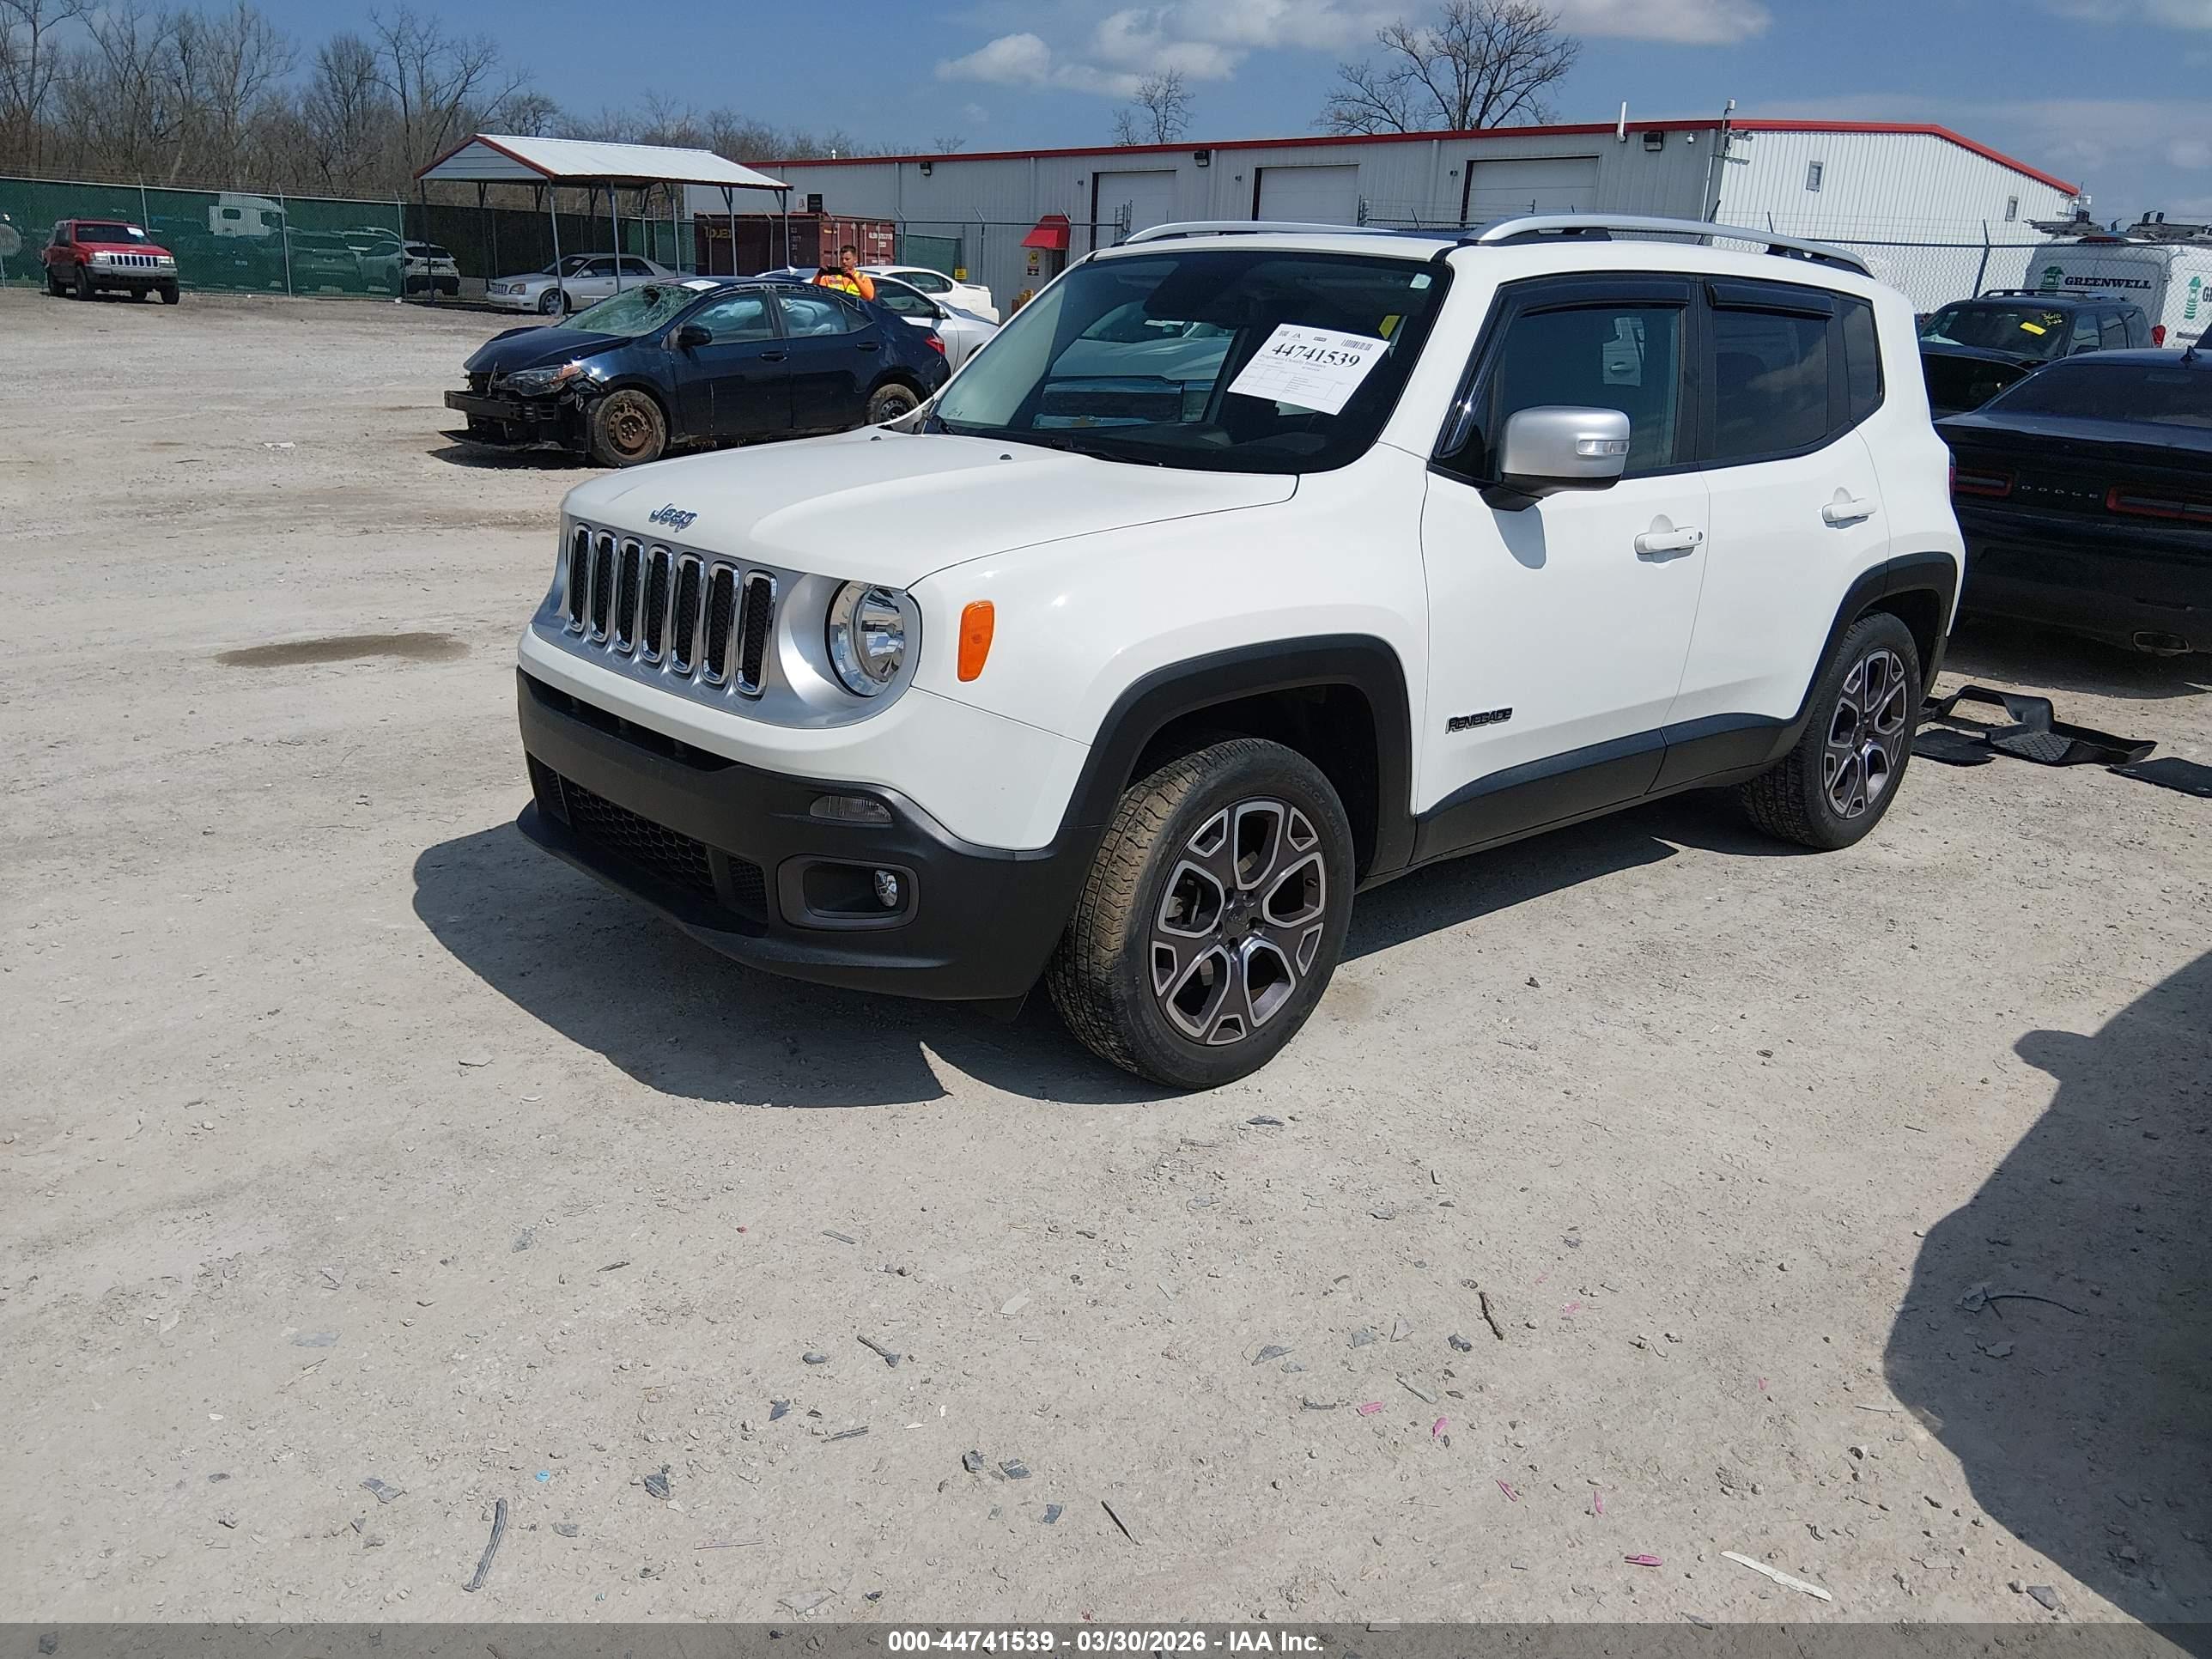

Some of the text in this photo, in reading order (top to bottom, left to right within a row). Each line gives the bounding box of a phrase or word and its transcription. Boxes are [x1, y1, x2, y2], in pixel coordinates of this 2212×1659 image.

[2064, 276, 2152, 289] GREENWELL
[2203, 286, 2212, 302] G
[1272, 343, 1361, 368] 44741539
[2021, 485, 2098, 498] DODGE
[648, 503, 697, 532] Jeep
[1445, 708, 1513, 734] RENEGADE
